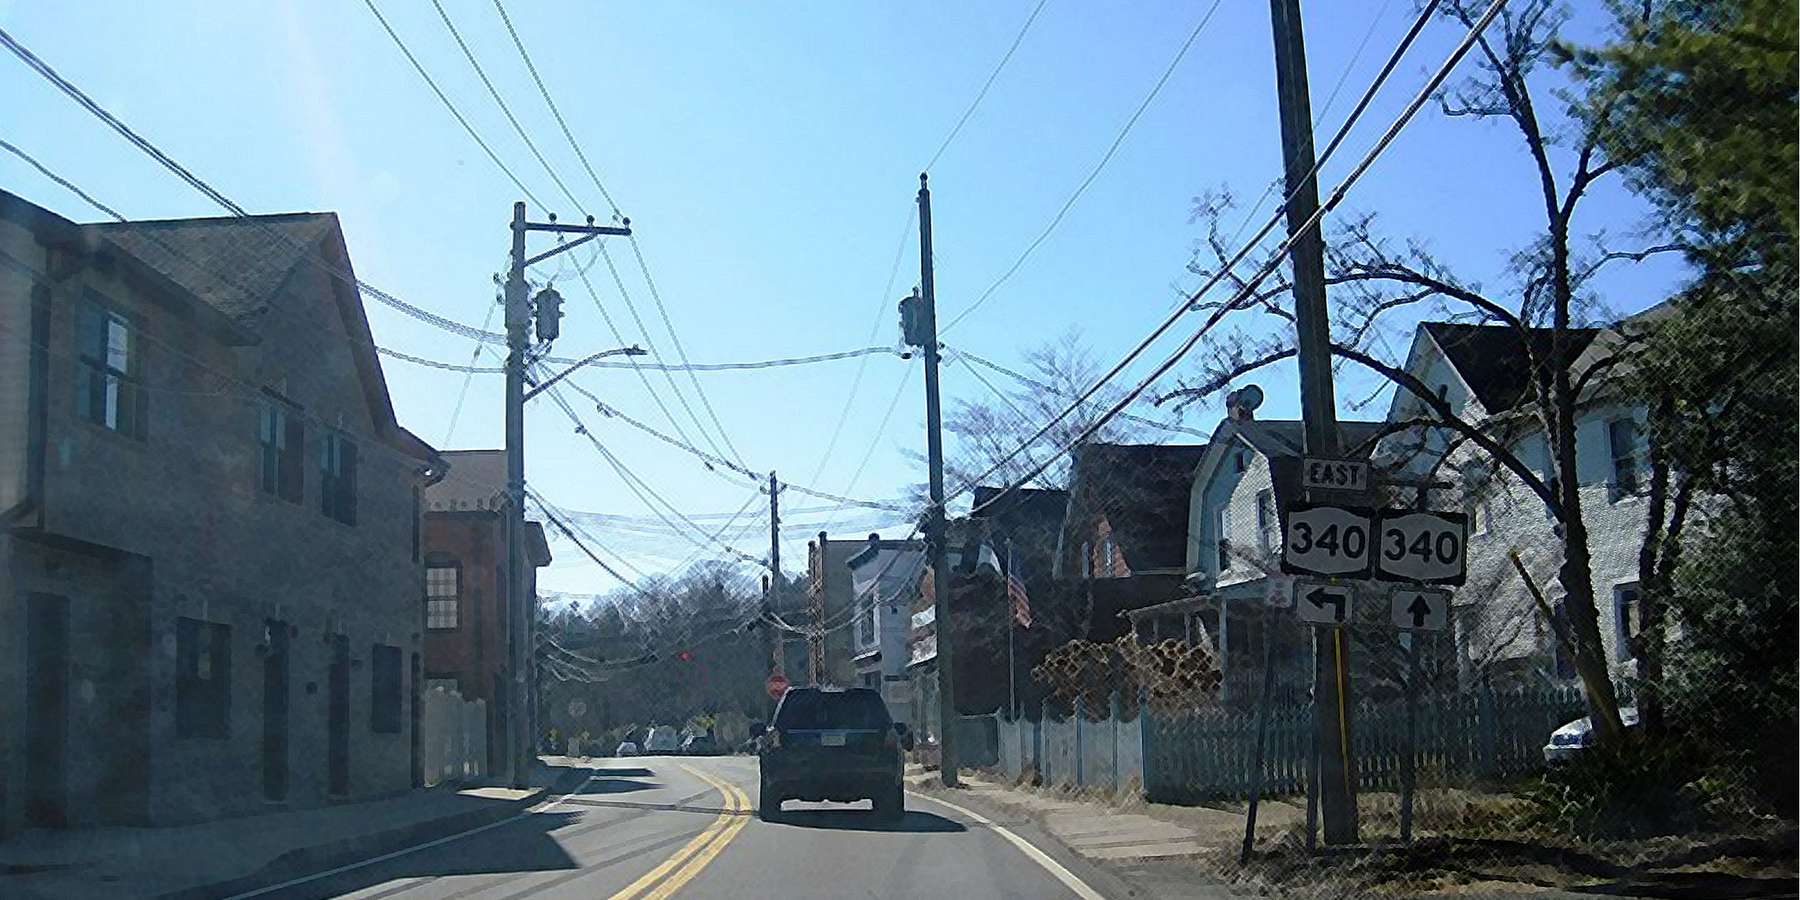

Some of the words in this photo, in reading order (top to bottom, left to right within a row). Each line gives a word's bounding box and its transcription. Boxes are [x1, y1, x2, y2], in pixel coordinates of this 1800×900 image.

[1309, 462, 1360, 486] EAST
[1291, 522, 1366, 559] 340
[1383, 528, 1459, 565] 340
